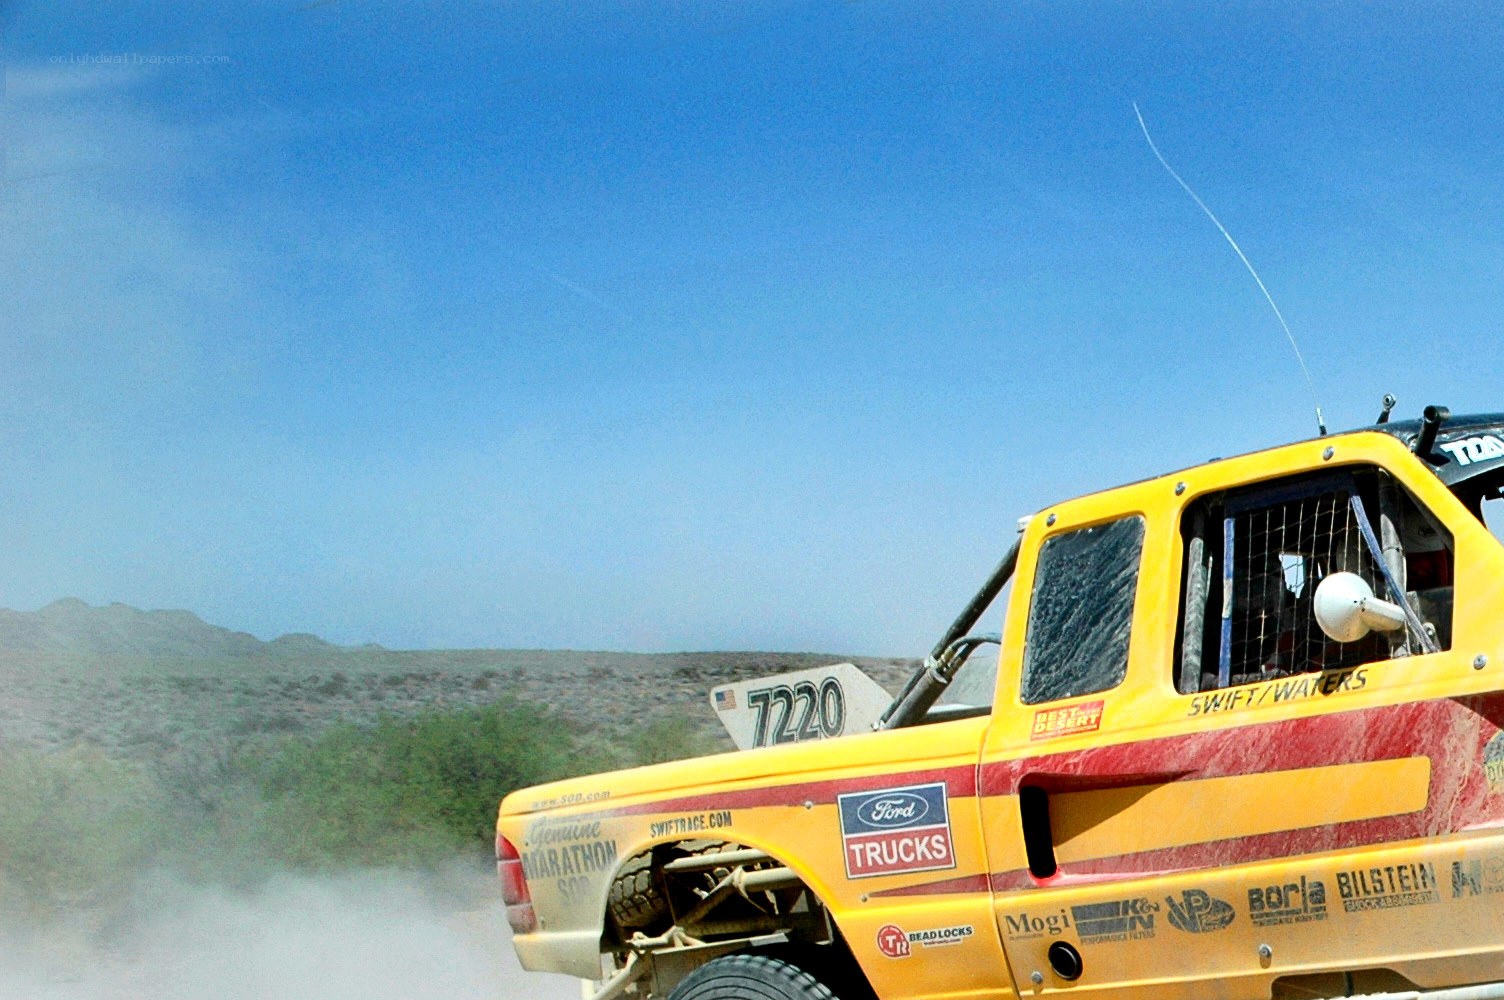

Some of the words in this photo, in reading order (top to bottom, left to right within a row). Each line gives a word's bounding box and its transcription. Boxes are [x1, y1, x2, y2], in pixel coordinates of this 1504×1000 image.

[747, 676, 847, 749] 7220
[1034, 713, 1100, 733] DESERT
[650, 811, 733, 838] SWIFTRACE.COM
[871, 798, 916, 821] Ford
[522, 839, 618, 880] MARATHON
[850, 834, 948, 868] TRUCKS
[1336, 861, 1438, 899] BILSTEIN
[1003, 908, 1071, 936] Mogi
